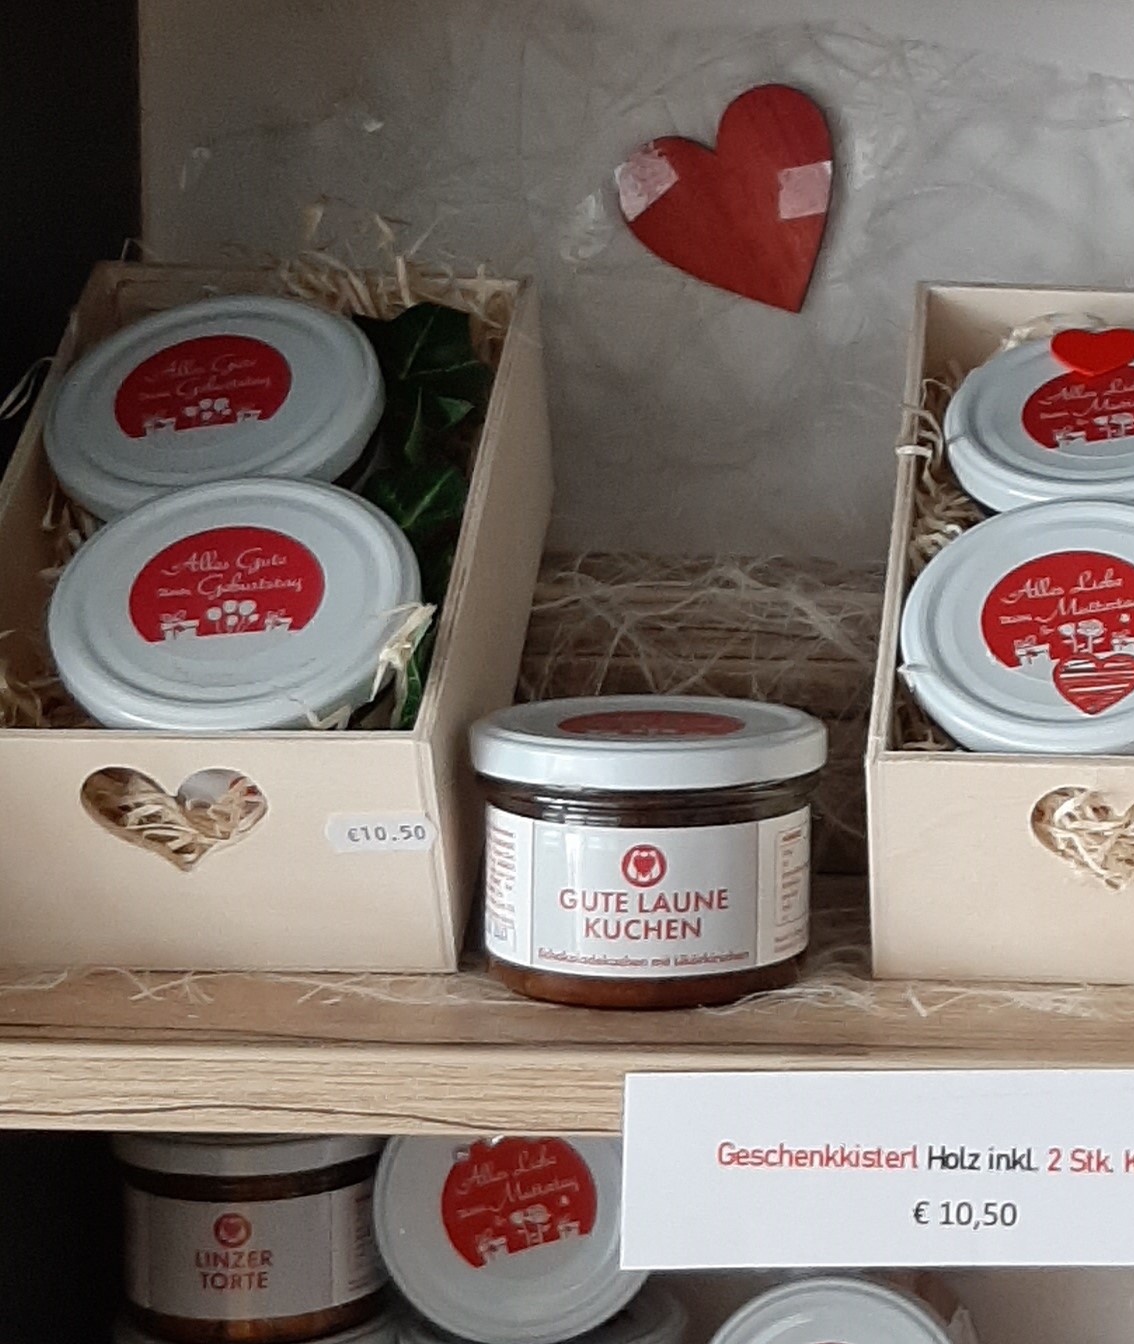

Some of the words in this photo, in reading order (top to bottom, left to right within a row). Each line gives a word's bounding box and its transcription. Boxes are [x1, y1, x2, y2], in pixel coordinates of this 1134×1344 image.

[346, 824, 427, 843] €10.50
[558, 888, 629, 914] GUTE
[637, 888, 729, 914] LAUNE
[584, 917, 702, 943] KUCHEN
[717, 1141, 918, 1171] Geschenkkisterl
[927, 1144, 979, 1172] Holz
[1047, 1148, 1064, 1172] 2
[1069, 1148, 1114, 1174] Stk.
[912, 1202, 930, 1226] €
[938, 1201, 1018, 1230] 10,50
[194, 1248, 274, 1269] LINZER
[201, 1271, 270, 1290] TORTE
